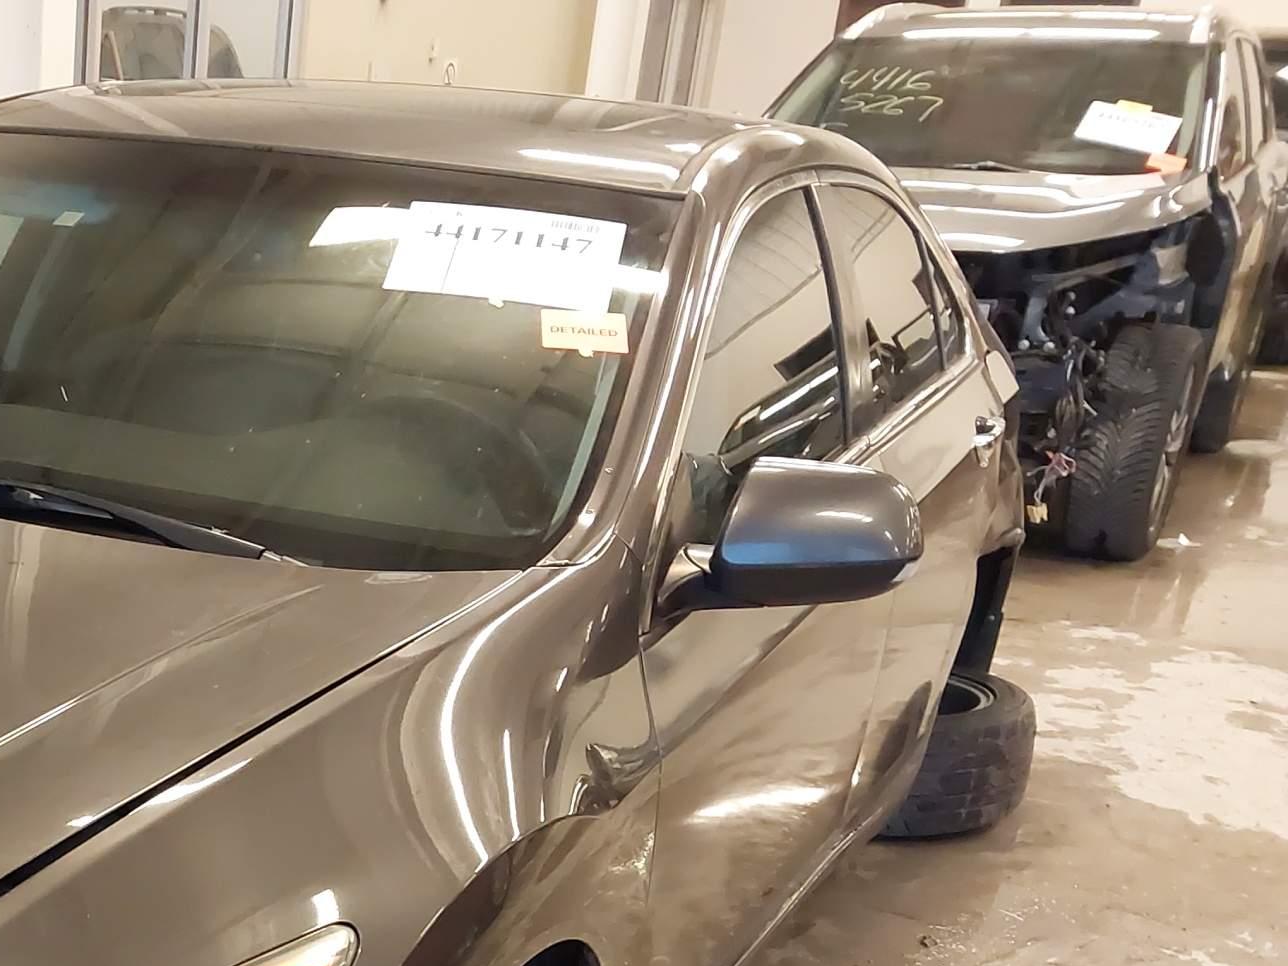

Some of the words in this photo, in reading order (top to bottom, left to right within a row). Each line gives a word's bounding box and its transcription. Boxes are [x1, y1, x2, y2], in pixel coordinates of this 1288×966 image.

[839, 66, 934, 91] 4416
[840, 93, 943, 122] 5267
[425, 223, 593, 254] 44171147
[550, 325, 618, 337] DETAILED
